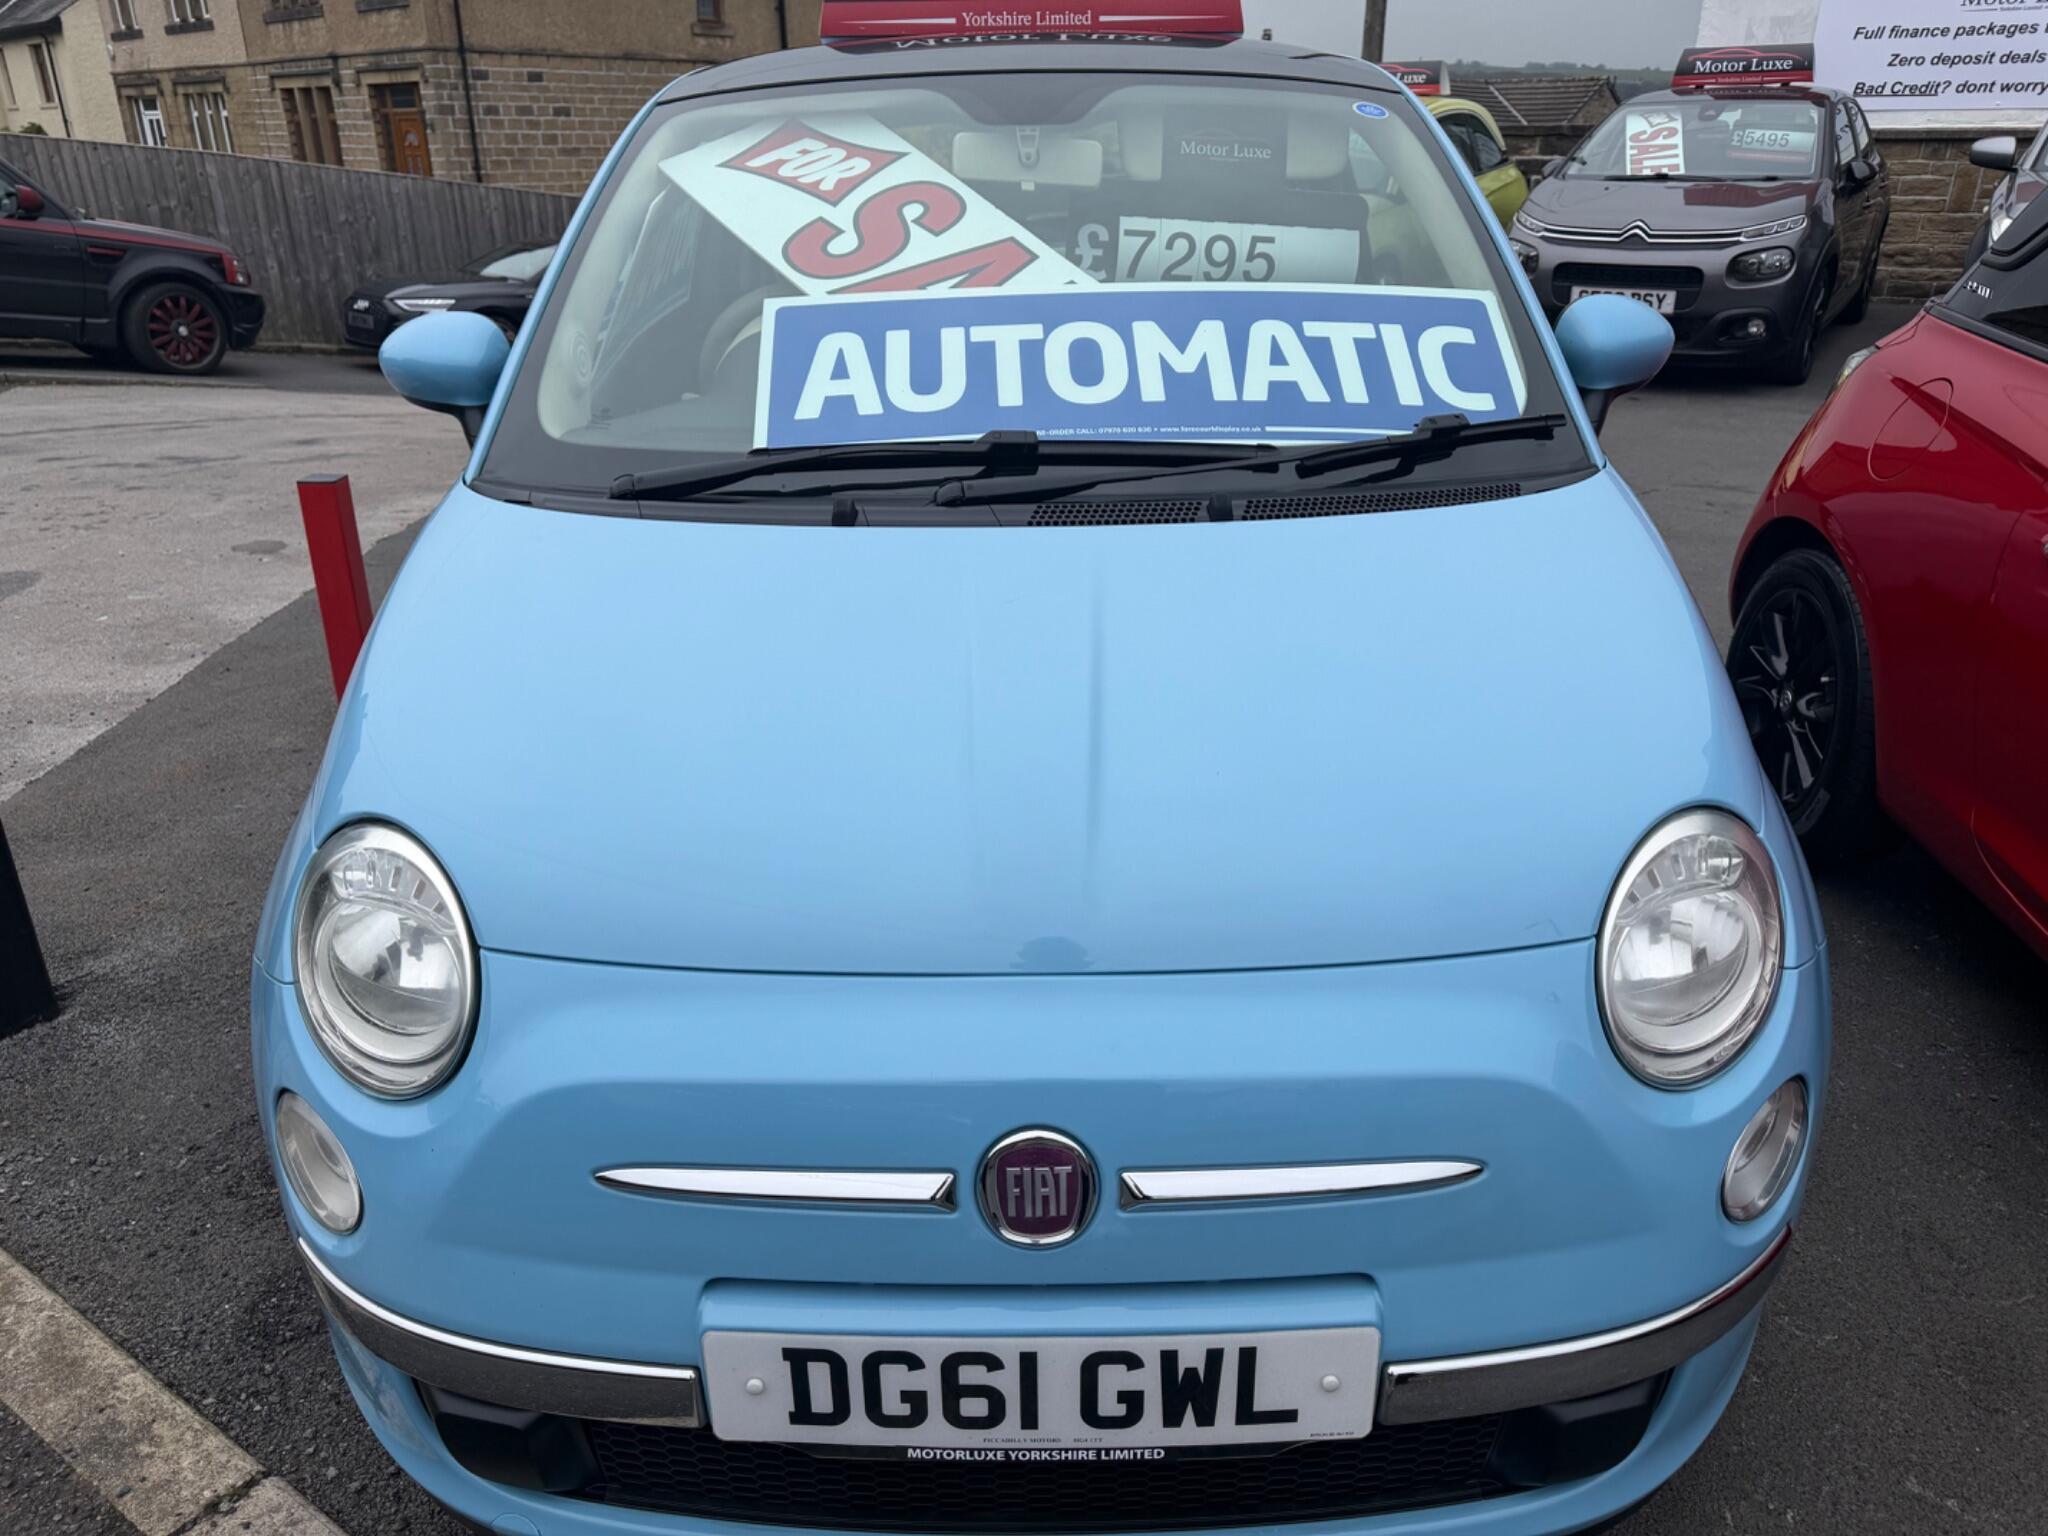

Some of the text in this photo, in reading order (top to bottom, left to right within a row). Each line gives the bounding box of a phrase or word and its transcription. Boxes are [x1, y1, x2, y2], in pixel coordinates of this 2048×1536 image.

[962, 10, 1092, 27] Yorkshire Limited
[1853, 26, 1885, 40] Full
[1888, 25, 1950, 39] finance
[1953, 22, 2040, 40] packages
[1694, 58, 1794, 73] Motor Luxe
[1887, 49, 2047, 68] Zero deposit deals
[1853, 80, 2048, 96] Bad Credit? dont worry
[1729, 130, 1790, 148] £5495
[1180, 140, 1272, 159] Motor Luxe
[744, 137, 871, 191] FOR
[1075, 223, 1276, 283] £7295
[793, 318, 1497, 421] AUTOMATIC
[1005, 1166, 1072, 1218] FIAT
[781, 1346, 1299, 1430] DG61 GWL
[907, 1447, 1165, 1461] MOTORLUXE YORKSHIRE LIMITED
